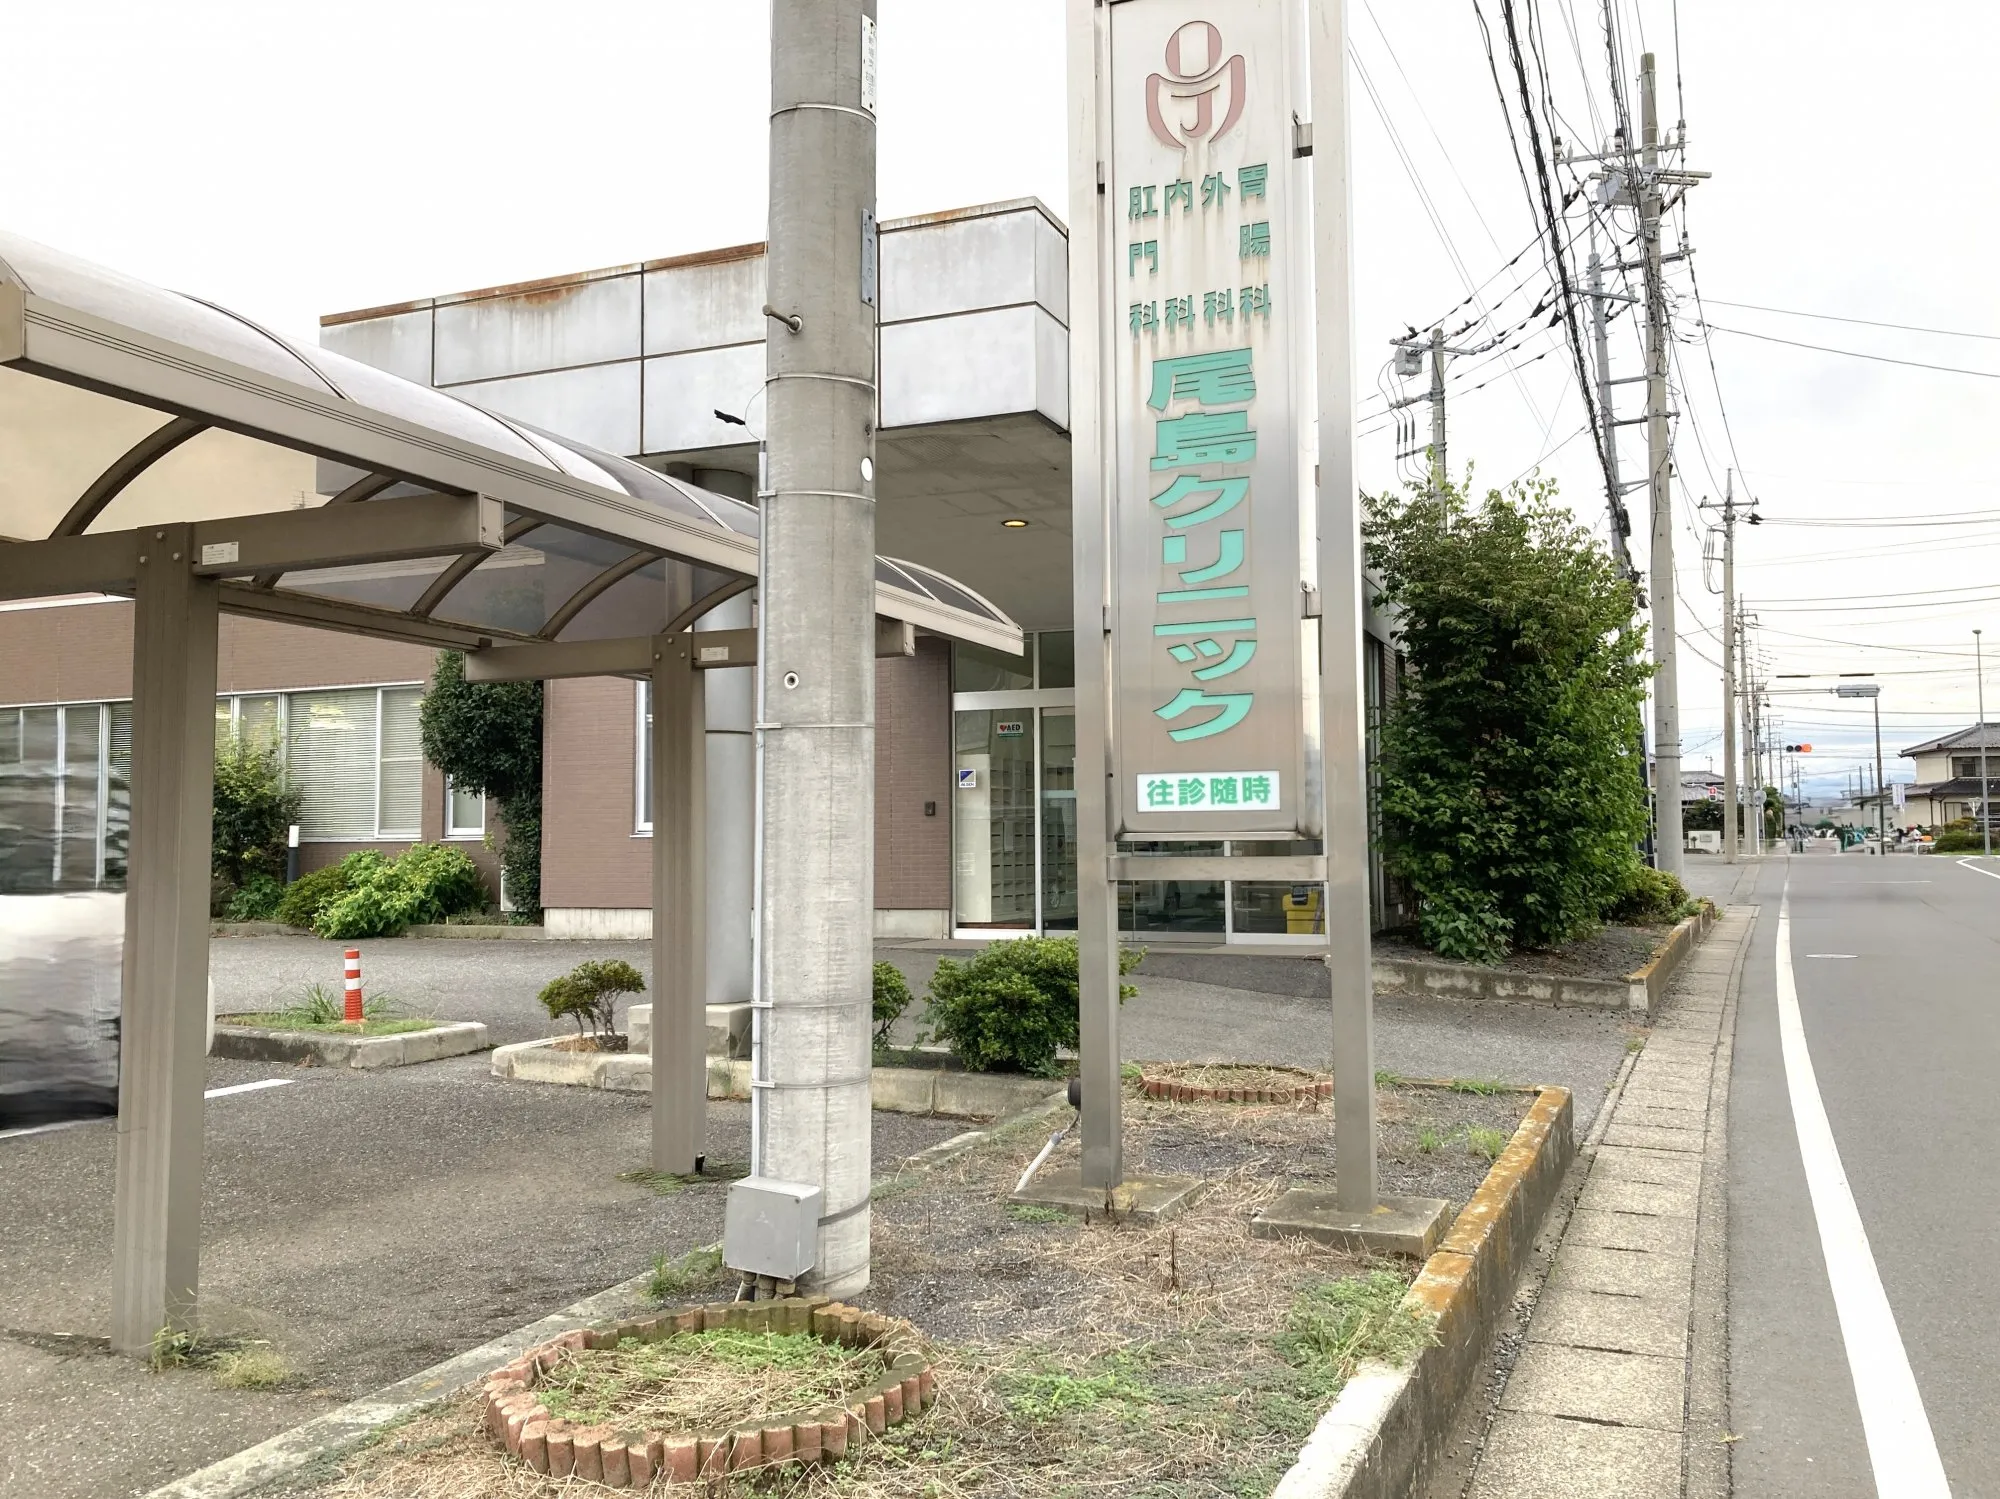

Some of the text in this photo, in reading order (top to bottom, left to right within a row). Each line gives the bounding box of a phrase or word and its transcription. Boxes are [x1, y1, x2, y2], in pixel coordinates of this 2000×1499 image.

[1128, 185, 1159, 337] 肛門科
[1164, 179, 1195, 332] 内科
[1200, 172, 1234, 326] 外科
[1238, 163, 1271, 323] 胃腸科
[1147, 348, 1257, 743] 尾島クリニック
[1006, 724, 1021, 732] AED
[1146, 776, 1271, 807] 往診随時
